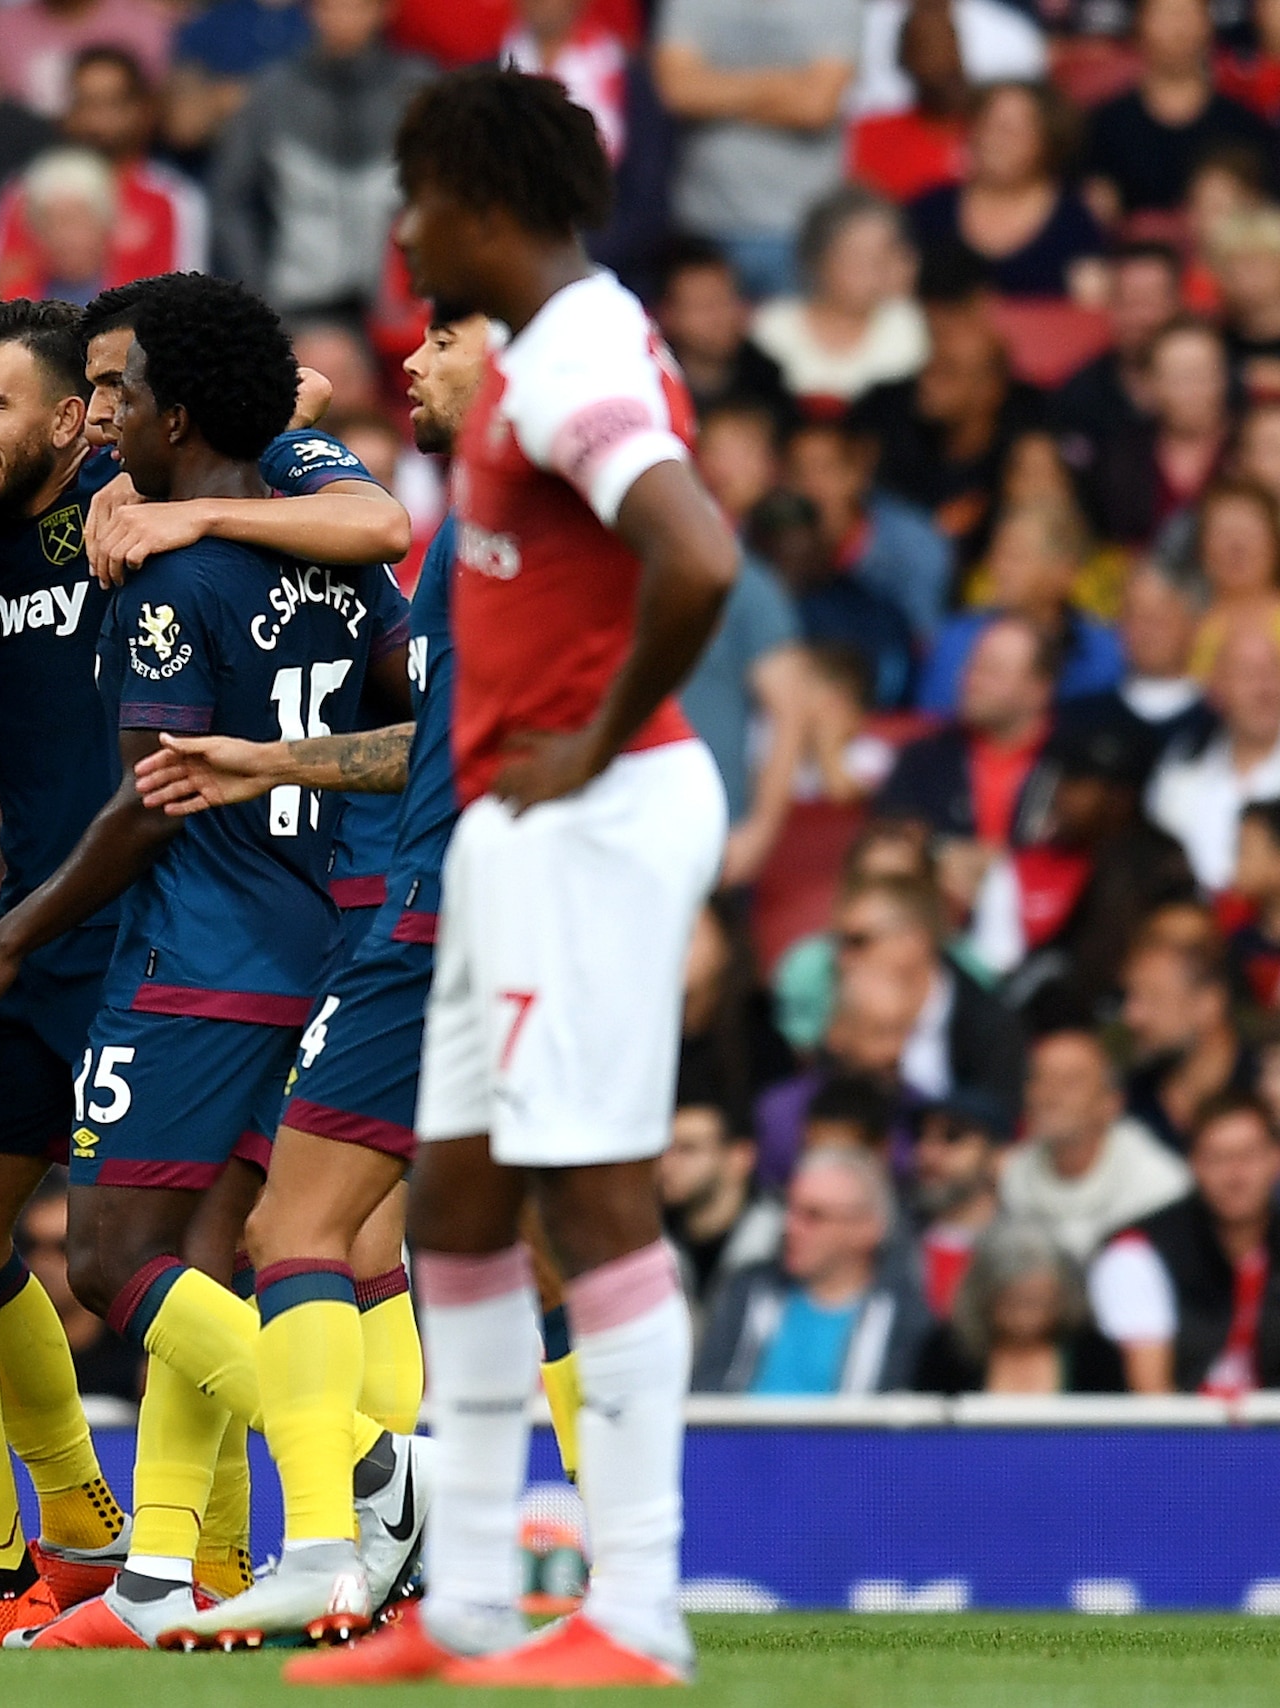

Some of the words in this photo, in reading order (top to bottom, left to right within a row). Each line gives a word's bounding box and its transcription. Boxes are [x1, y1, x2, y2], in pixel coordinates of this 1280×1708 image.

[149, 667, 161, 680] &
[160, 643, 193, 678] GOLD
[497, 986, 541, 1072] 7
[73, 1045, 136, 1124] 15
